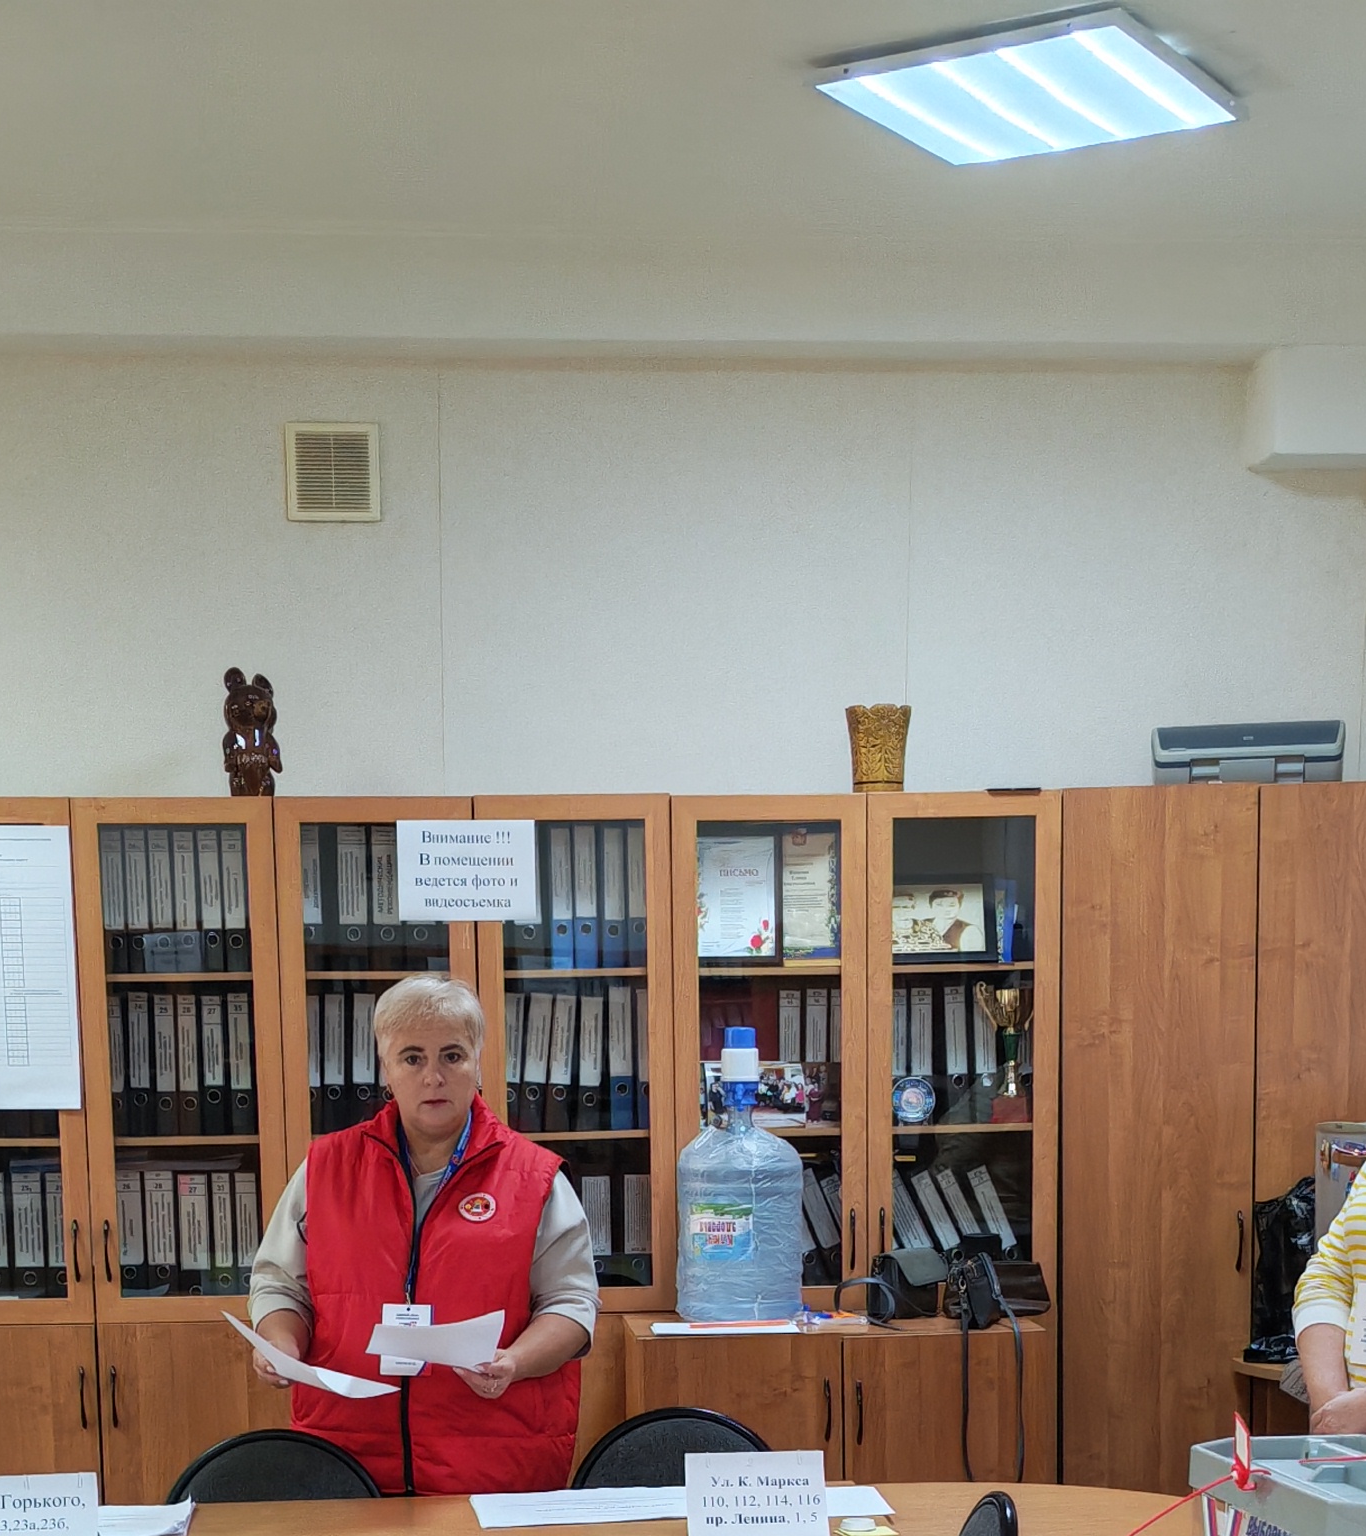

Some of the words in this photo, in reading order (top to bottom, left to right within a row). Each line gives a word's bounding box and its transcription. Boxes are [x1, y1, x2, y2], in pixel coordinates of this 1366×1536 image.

[421, 830, 492, 845] Внимание
[495, 830, 511, 845] !!!
[419, 852, 431, 866] В
[433, 855, 514, 868] помещении
[414, 876, 467, 888] ведется
[471, 874, 505, 890] фото
[509, 877, 518, 887] и
[424, 896, 512, 909] видеосъемка
[711, 1476, 734, 1488] Ул.
[738, 1476, 753, 1488] К.
[756, 1476, 810, 1489] Маркса
[0, 1494, 86, 1513] Горького,
[702, 1496, 729, 1509] 110,
[734, 1495, 761, 1508] 112,
[766, 1495, 792, 1508] 114,
[798, 1494, 821, 1506] 116
[706, 1515, 728, 1527] пр.
[731, 1513, 791, 1526] Ленина,
[795, 1512, 807, 1524] 1,
[810, 1512, 818, 1523] 5
